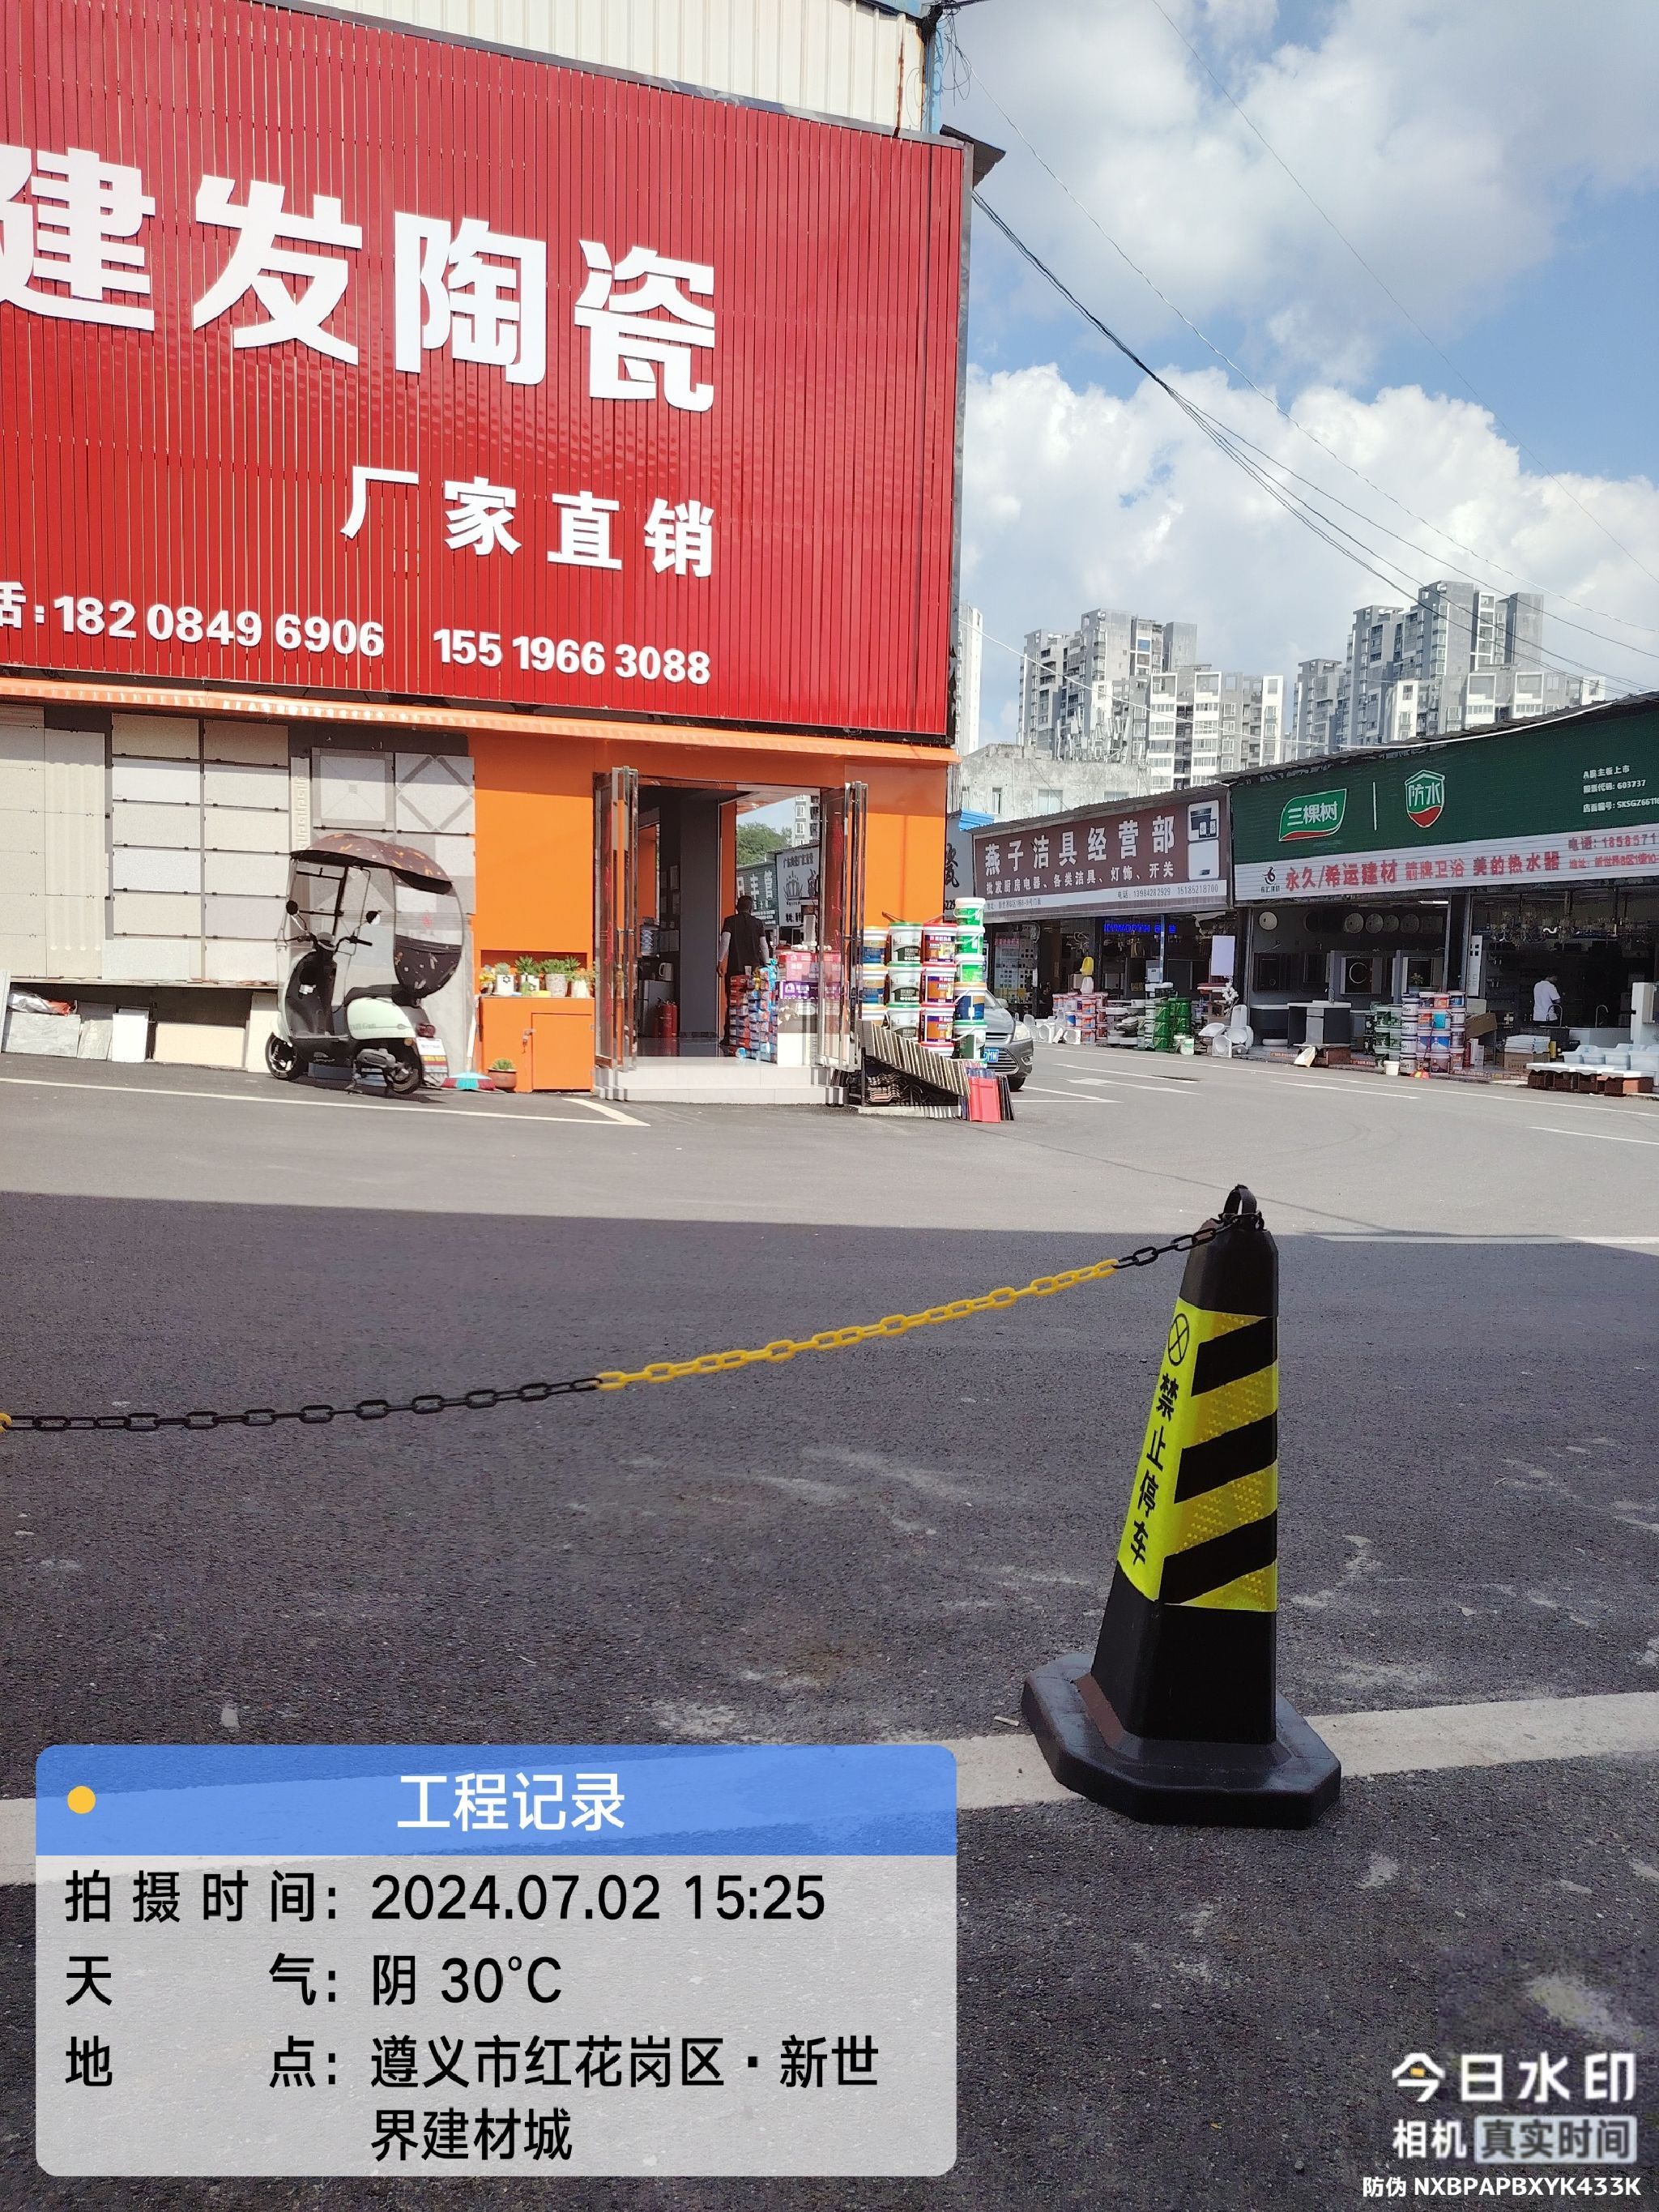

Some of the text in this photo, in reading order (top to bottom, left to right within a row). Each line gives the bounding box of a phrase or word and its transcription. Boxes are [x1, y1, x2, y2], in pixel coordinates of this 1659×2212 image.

[0, 144, 715, 412] 建发陶瓷
[340, 465, 714, 578] 厂家直销
[53, 596, 137, 638] 182
[147, 603, 262, 646] 0849
[275, 613, 385, 656] 6906
[433, 628, 503, 667] 155
[514, 636, 606, 675] 1966
[615, 643, 711, 685] 3088
[1287, 801, 1338, 826] 三棵树
[1408, 782, 1441, 807] 防水
[1617, 779, 1647, 790] 603737
[984, 814, 1175, 877] 燕子洁具经营部
[1286, 851, 1560, 892] 永久/希运建材 箭牌卫浴 美的热水器
[1130, 1373, 1179, 1565] 禁止停车
